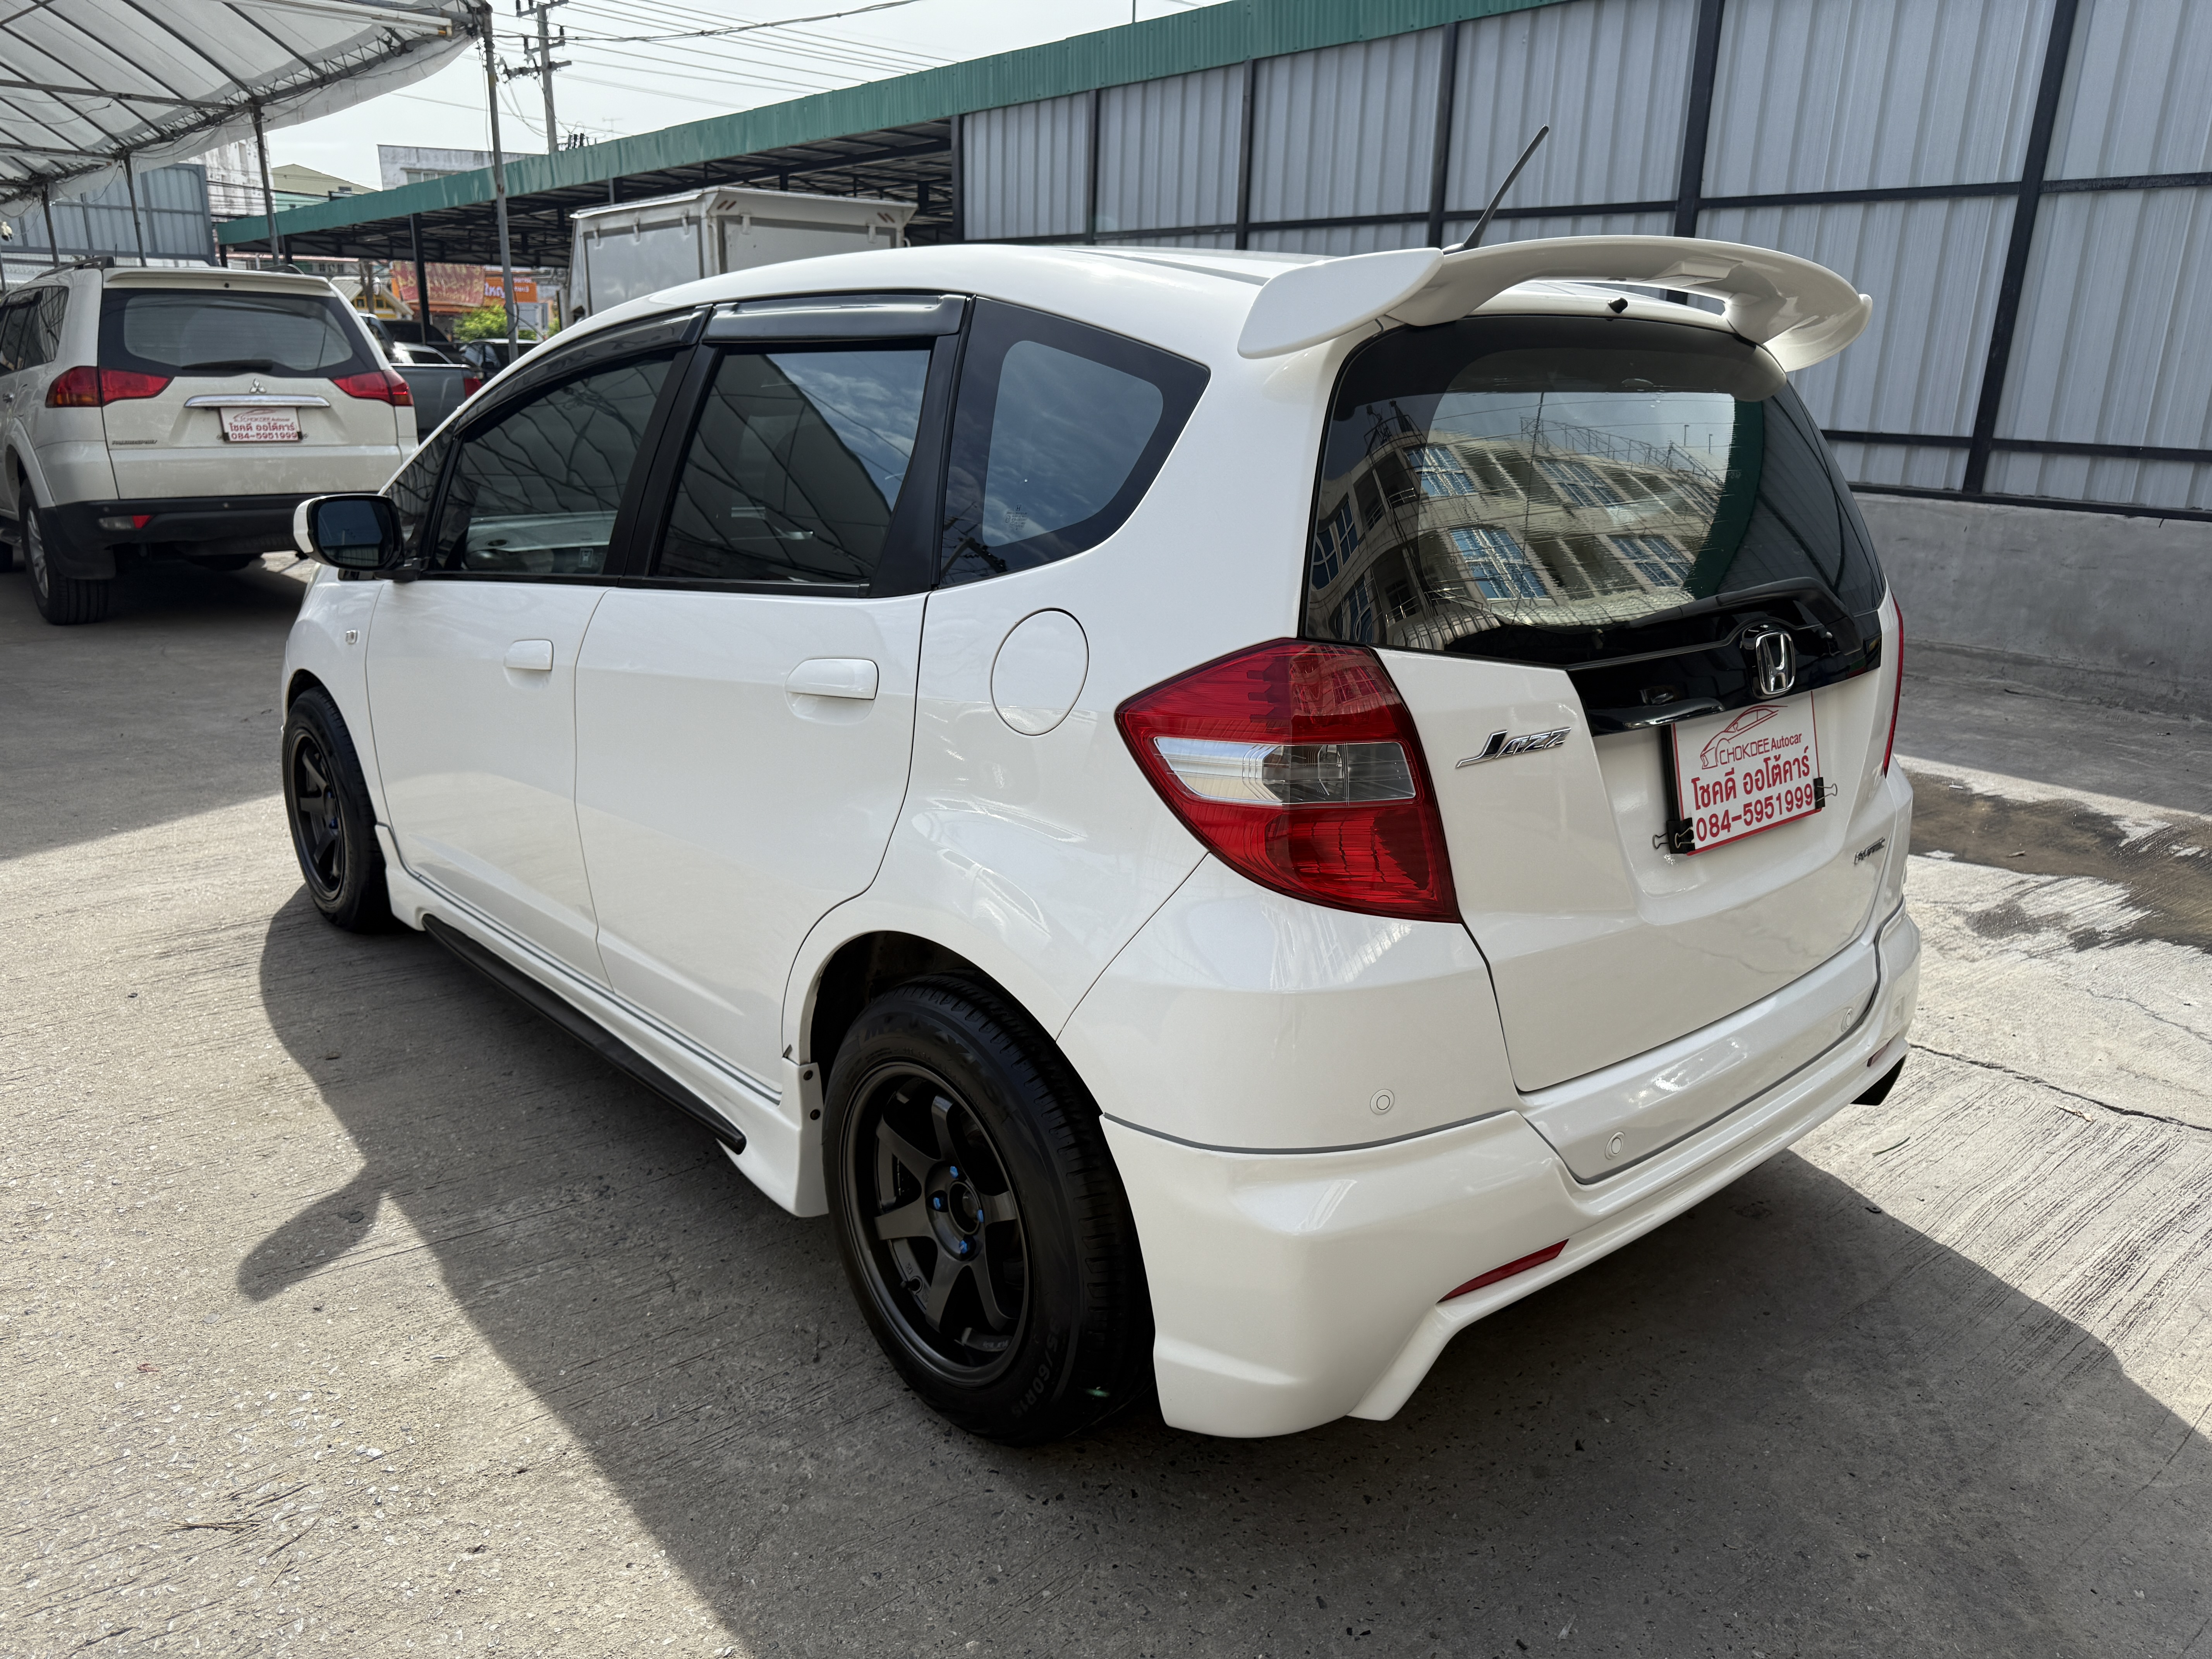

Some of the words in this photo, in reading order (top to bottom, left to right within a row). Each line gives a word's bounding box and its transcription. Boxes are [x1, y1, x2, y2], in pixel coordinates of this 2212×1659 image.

[1691, 767, 1737, 811] โชคดี
[1743, 745, 1810, 795] ออโต้คาร์
[1719, 737, 1770, 765] CHOKDEE
[1771, 733, 1802, 751] Autocar
[1696, 783, 1813, 842] 084-5951999
